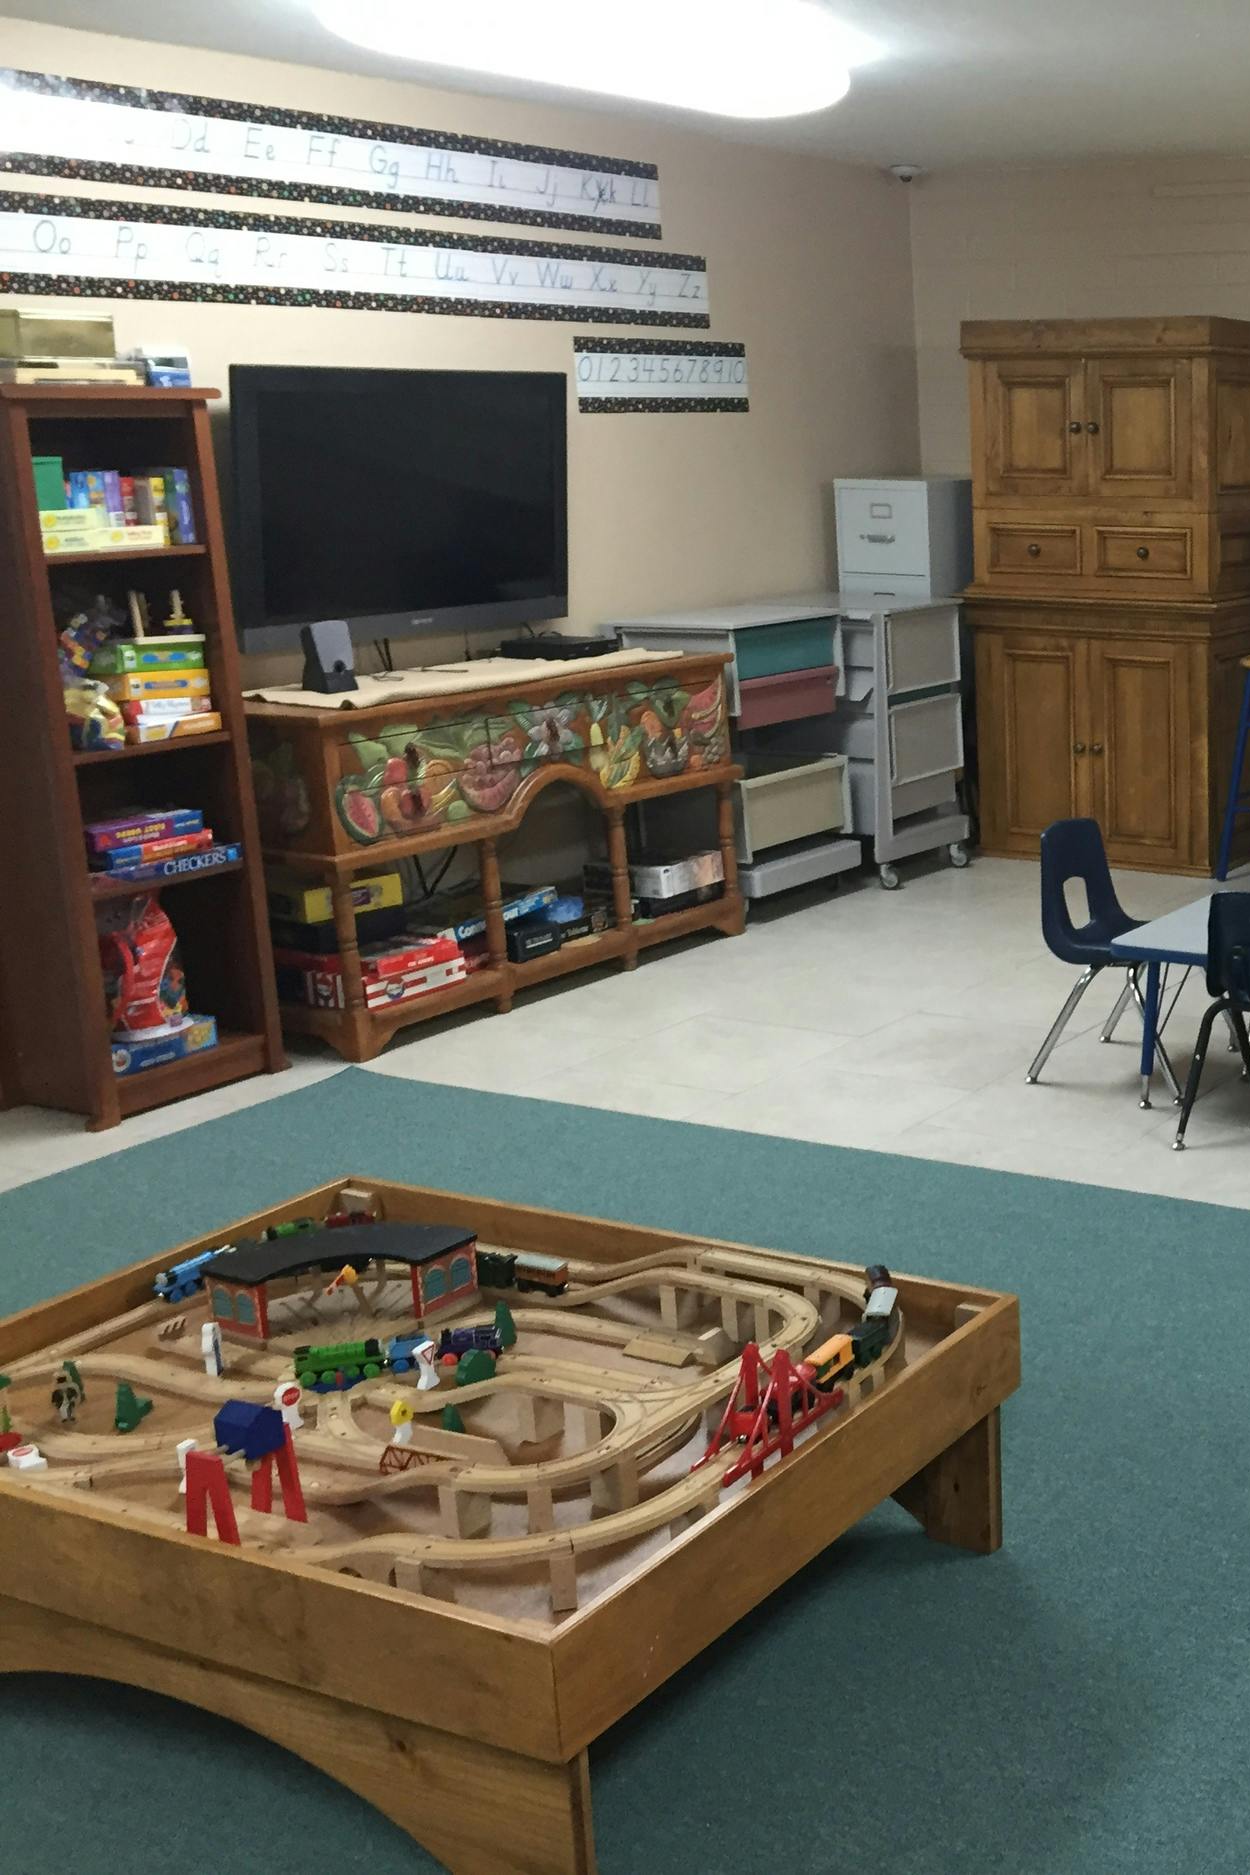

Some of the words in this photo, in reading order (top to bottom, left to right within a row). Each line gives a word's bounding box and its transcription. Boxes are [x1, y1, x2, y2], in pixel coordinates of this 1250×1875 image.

[171, 118, 209, 153] Dd
[244, 126, 276, 161] Ee
[307, 134, 341, 168] Ff
[369, 145, 399, 188] Gg
[426, 154, 458, 183] Hh
[535, 168, 558, 207] Jj
[33, 219, 72, 256] Oo
[115, 225, 148, 274] Pp
[255, 236, 288, 269] Rr
[381, 246, 407, 278] Tt
[434, 252, 468, 282] Uu
[635, 270, 657, 306] Yy
[677, 273, 701, 299] Zz
[164, 850, 227, 876] CHECKERS
